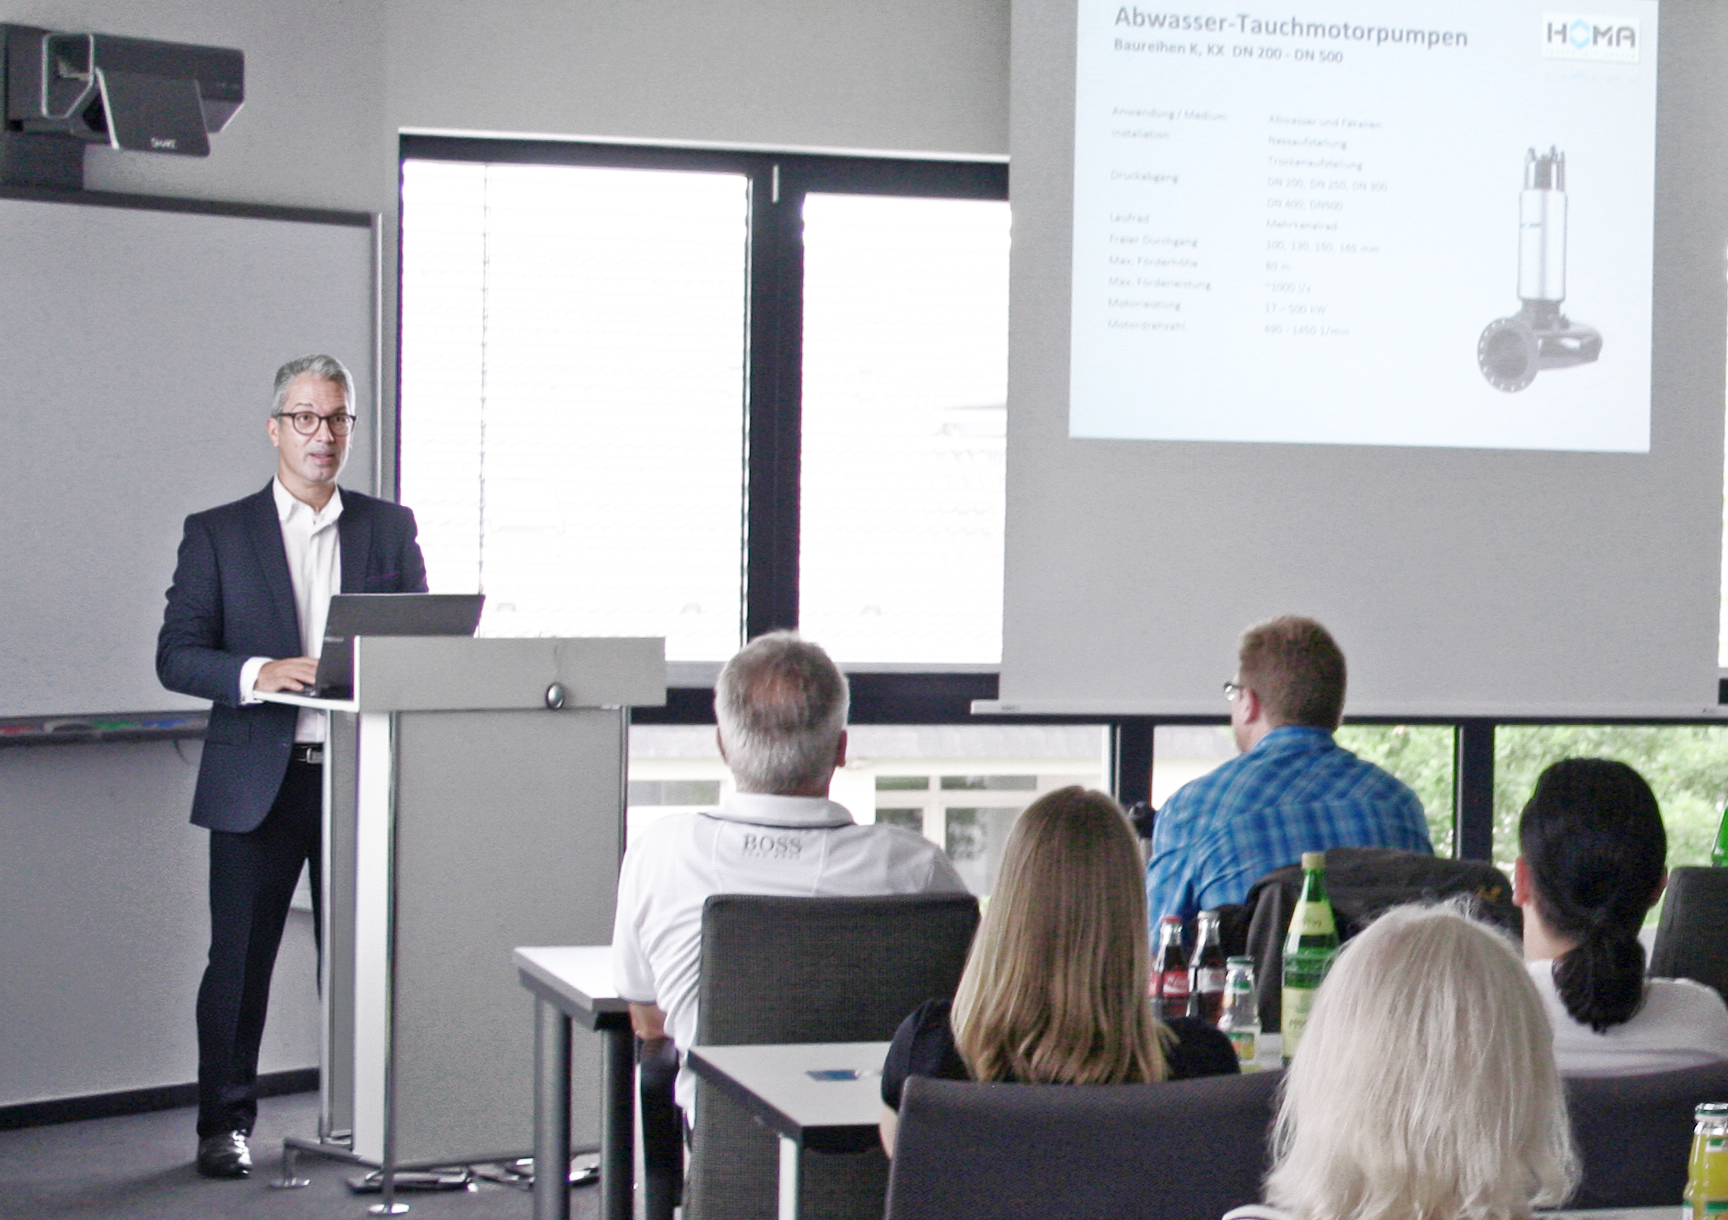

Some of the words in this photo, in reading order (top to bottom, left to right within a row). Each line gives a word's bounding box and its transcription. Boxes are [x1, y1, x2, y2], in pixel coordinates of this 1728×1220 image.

[1114, 5, 1468, 49] Abwasser-Tauchmotorpumpen
[1546, 19, 1637, 49] HOMA
[1114, 38, 1186, 54] Baureihen
[1189, 42, 1202, 57] K,
[1232, 44, 1253, 59] DN
[1257, 46, 1282, 61] 200
[1294, 49, 1315, 62] DN
[1319, 50, 1343, 63] 500
[1112, 106, 1175, 121] Anwendung
[743, 833, 803, 854] BOSS
